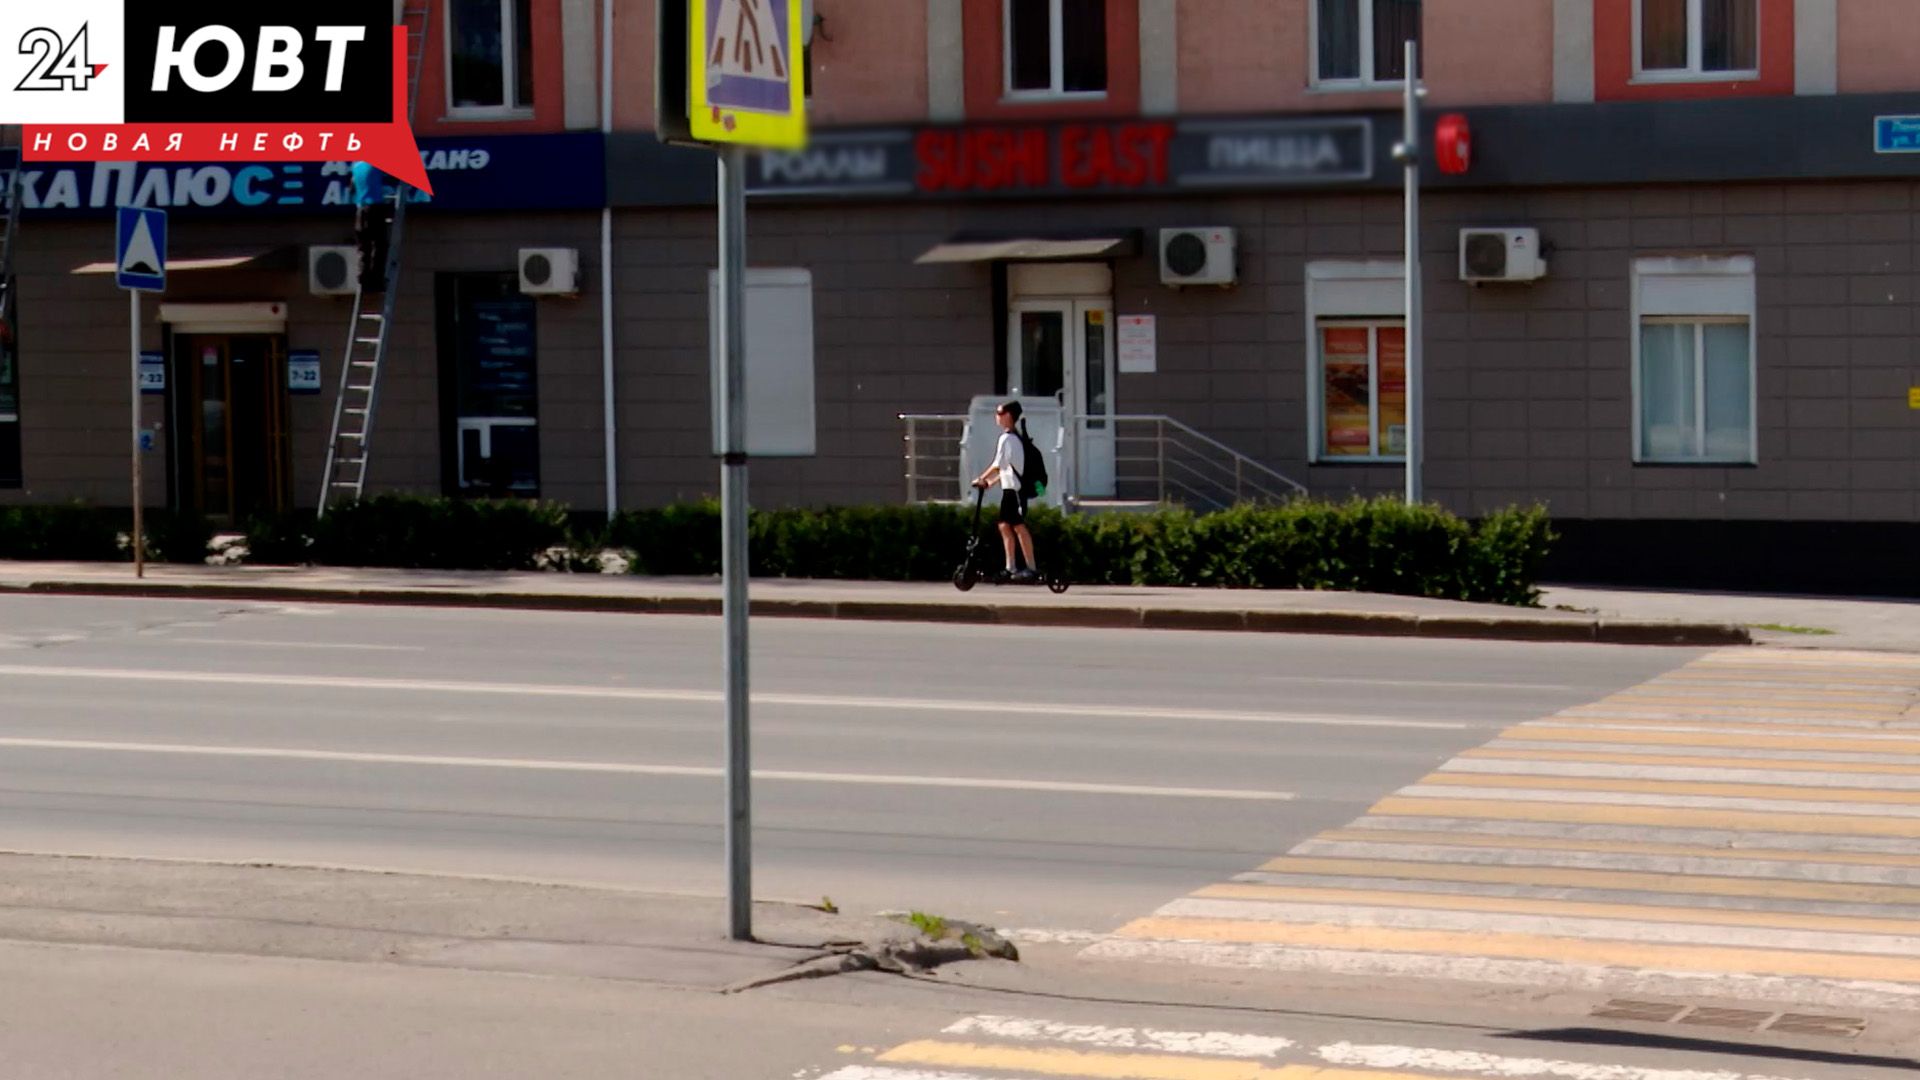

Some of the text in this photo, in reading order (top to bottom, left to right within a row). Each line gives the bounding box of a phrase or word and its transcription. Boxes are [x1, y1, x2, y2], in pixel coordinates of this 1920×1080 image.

[917, 121, 1171, 190] SUSHI EAST
[1207, 134, 1341, 170] ПИЦЦА
